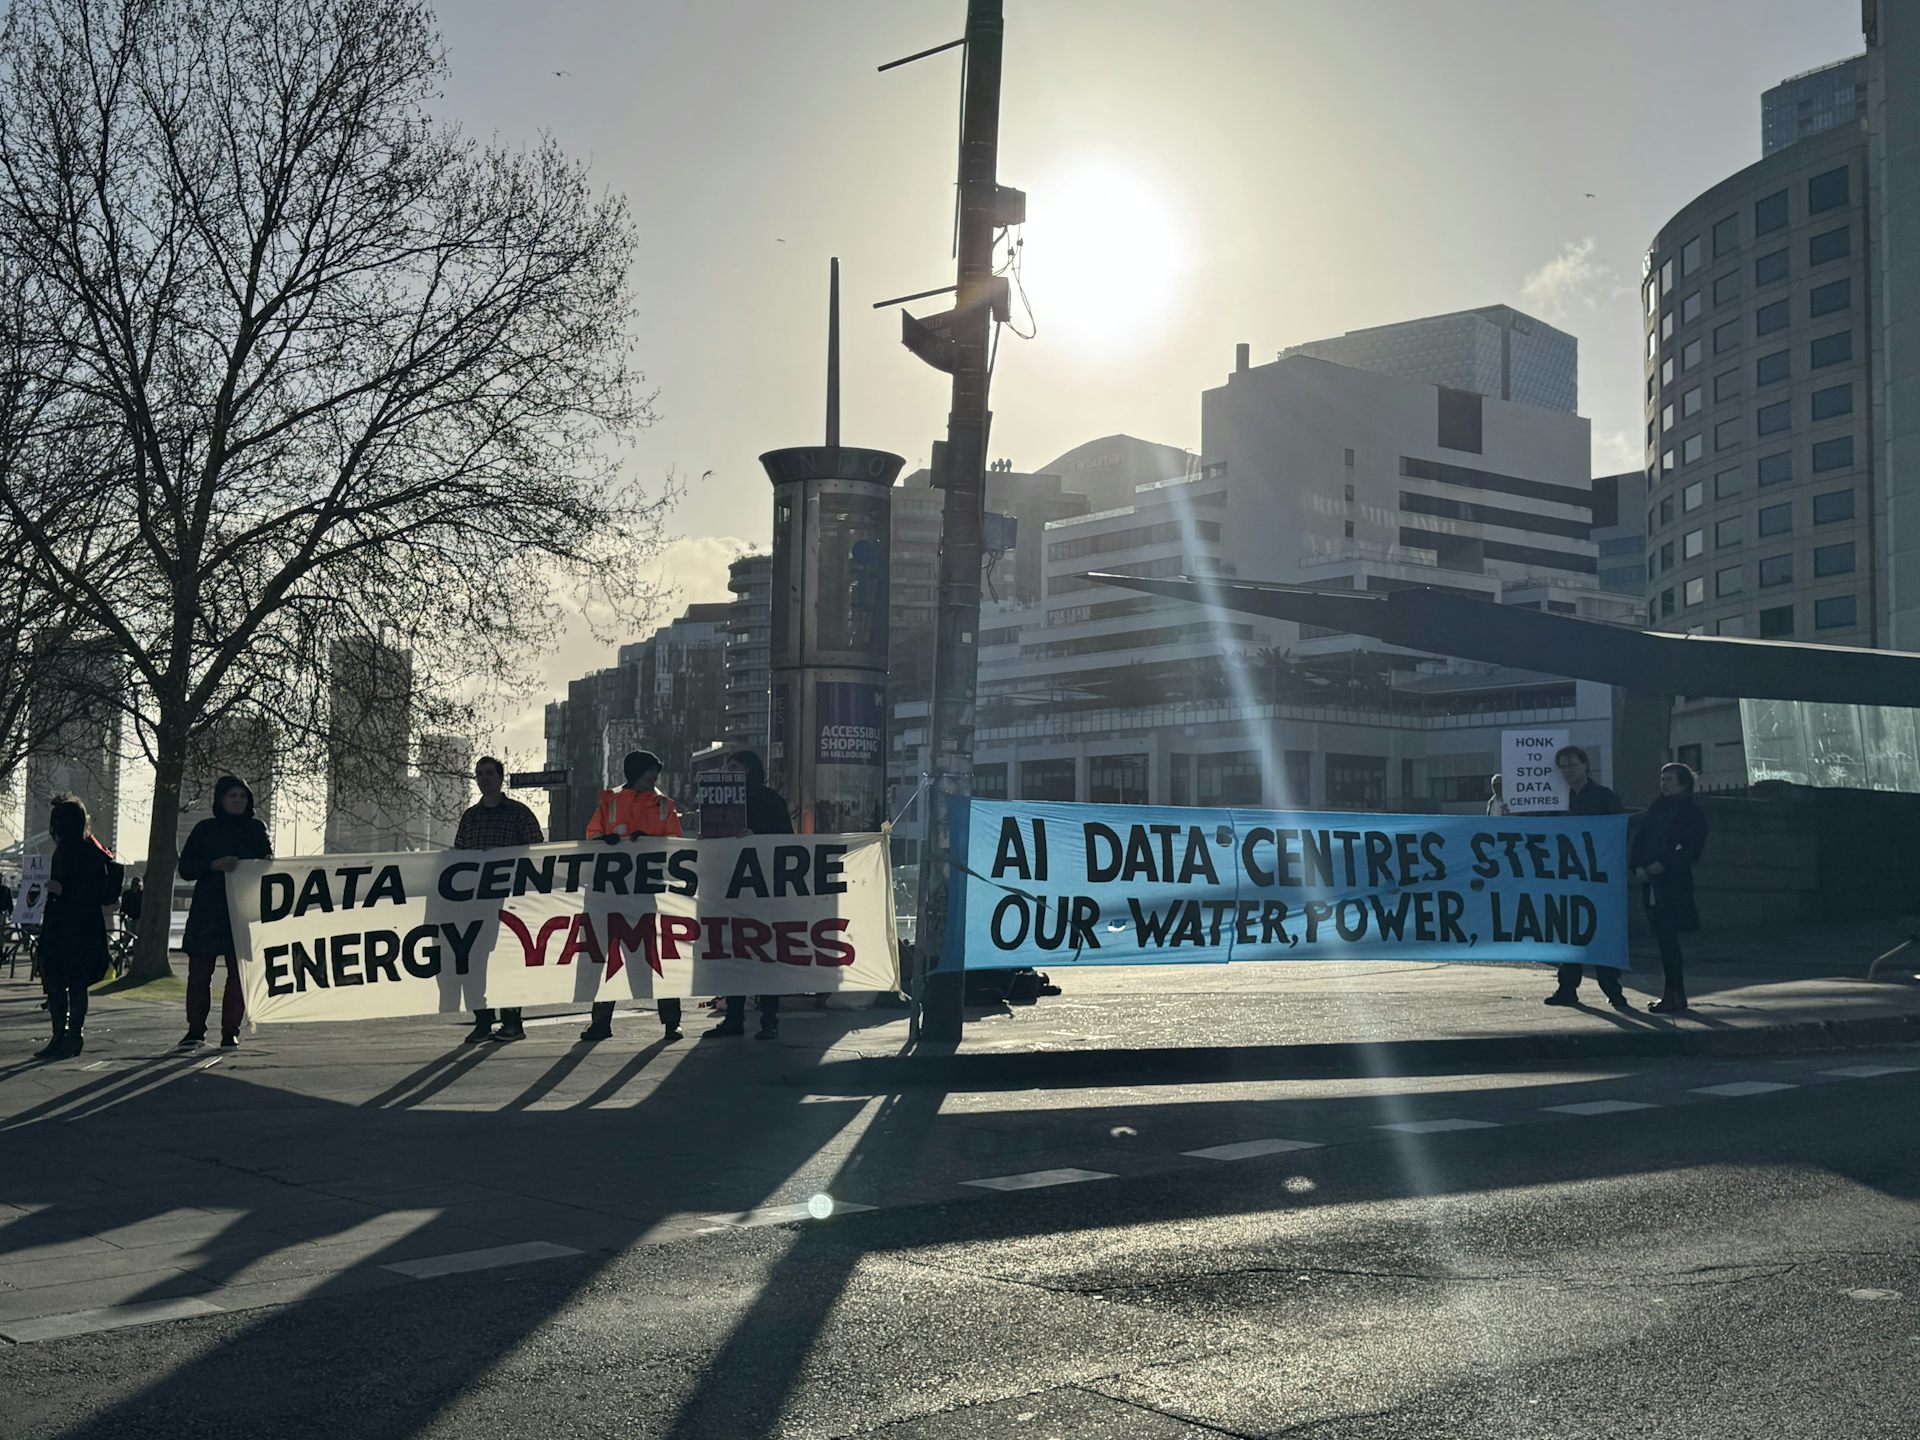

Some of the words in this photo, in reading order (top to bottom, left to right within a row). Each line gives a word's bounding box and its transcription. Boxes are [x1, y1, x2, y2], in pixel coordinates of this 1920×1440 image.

[780, 452, 885, 477] INFO
[1066, 454, 1124, 472] Transurban
[821, 725, 881, 740] ACCESSIBLE
[821, 738, 878, 752] SHOPPING
[1516, 737, 1554, 747] HONK
[1528, 753, 1542, 761] TO
[1517, 767, 1552, 776] STOP
[700, 786, 746, 804] PEOPLE
[1516, 782, 1552, 792] DATA
[1510, 796, 1559, 806] CENTRES
[991, 816, 1048, 881] AI
[1083, 822, 1220, 885] DATA
[1241, 827, 1447, 888] CENTRES
[1470, 831, 1608, 884] STEAL
[260, 865, 407, 923] DATA
[438, 849, 698, 901] CENTRES
[725, 844, 848, 899] ARE
[990, 894, 1101, 950] OUR
[1490, 892, 1597, 946] LAND
[264, 919, 485, 998] ENERGY
[498, 909, 856, 983] VAMPIRES
